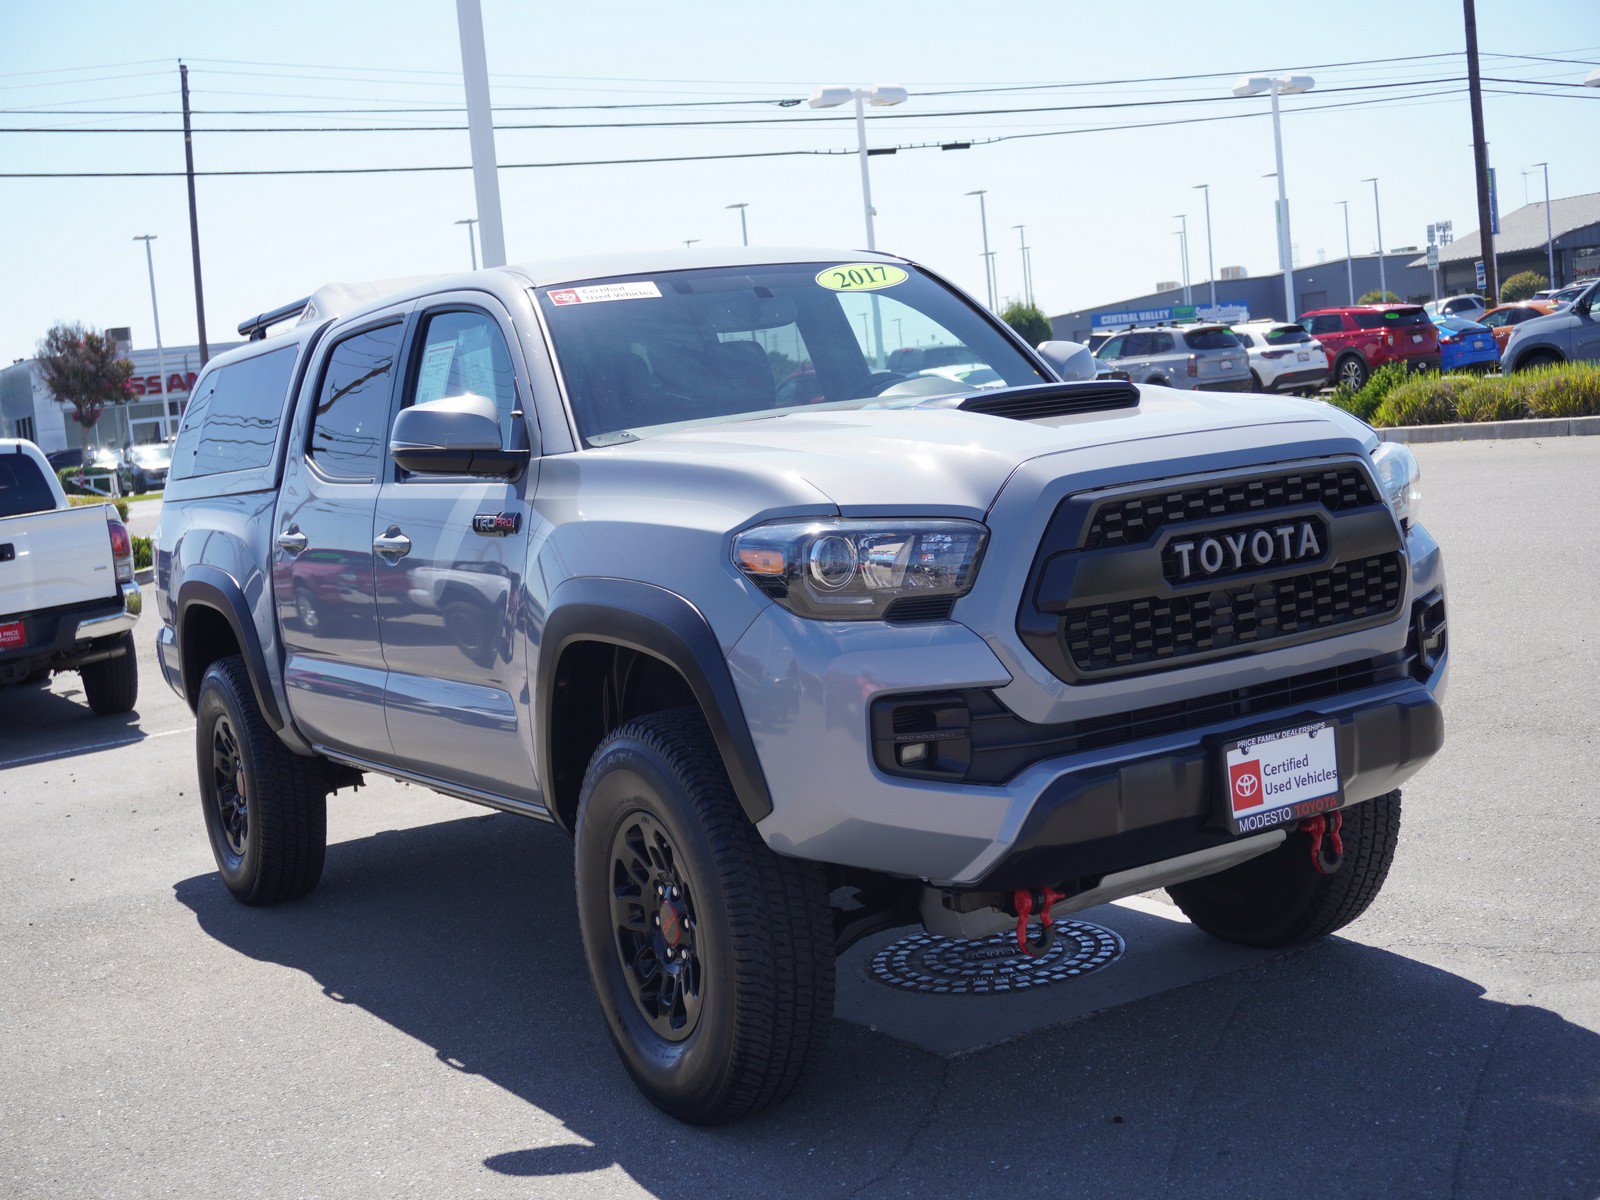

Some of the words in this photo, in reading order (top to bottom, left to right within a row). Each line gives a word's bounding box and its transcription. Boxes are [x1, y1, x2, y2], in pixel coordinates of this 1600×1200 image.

[833, 266, 887, 288] 2017
[582, 286, 625, 294] Certified
[586, 293, 611, 301] Used
[1101, 313, 1138, 325] CENTRAL
[1139, 309, 1170, 321] VALLEY
[1172, 522, 1321, 578] TOYOTA
[1237, 738, 1257, 749] PRICE
[1257, 732, 1281, 744] FAMILY
[1281, 722, 1326, 738] DEALERSHIPS
[1263, 754, 1309, 777] Certified
[1265, 778, 1292, 795] Used
[1294, 769, 1337, 788] Vehicles
[1239, 807, 1291, 833] MODESTO
[1295, 796, 1337, 816] TOYOTA
